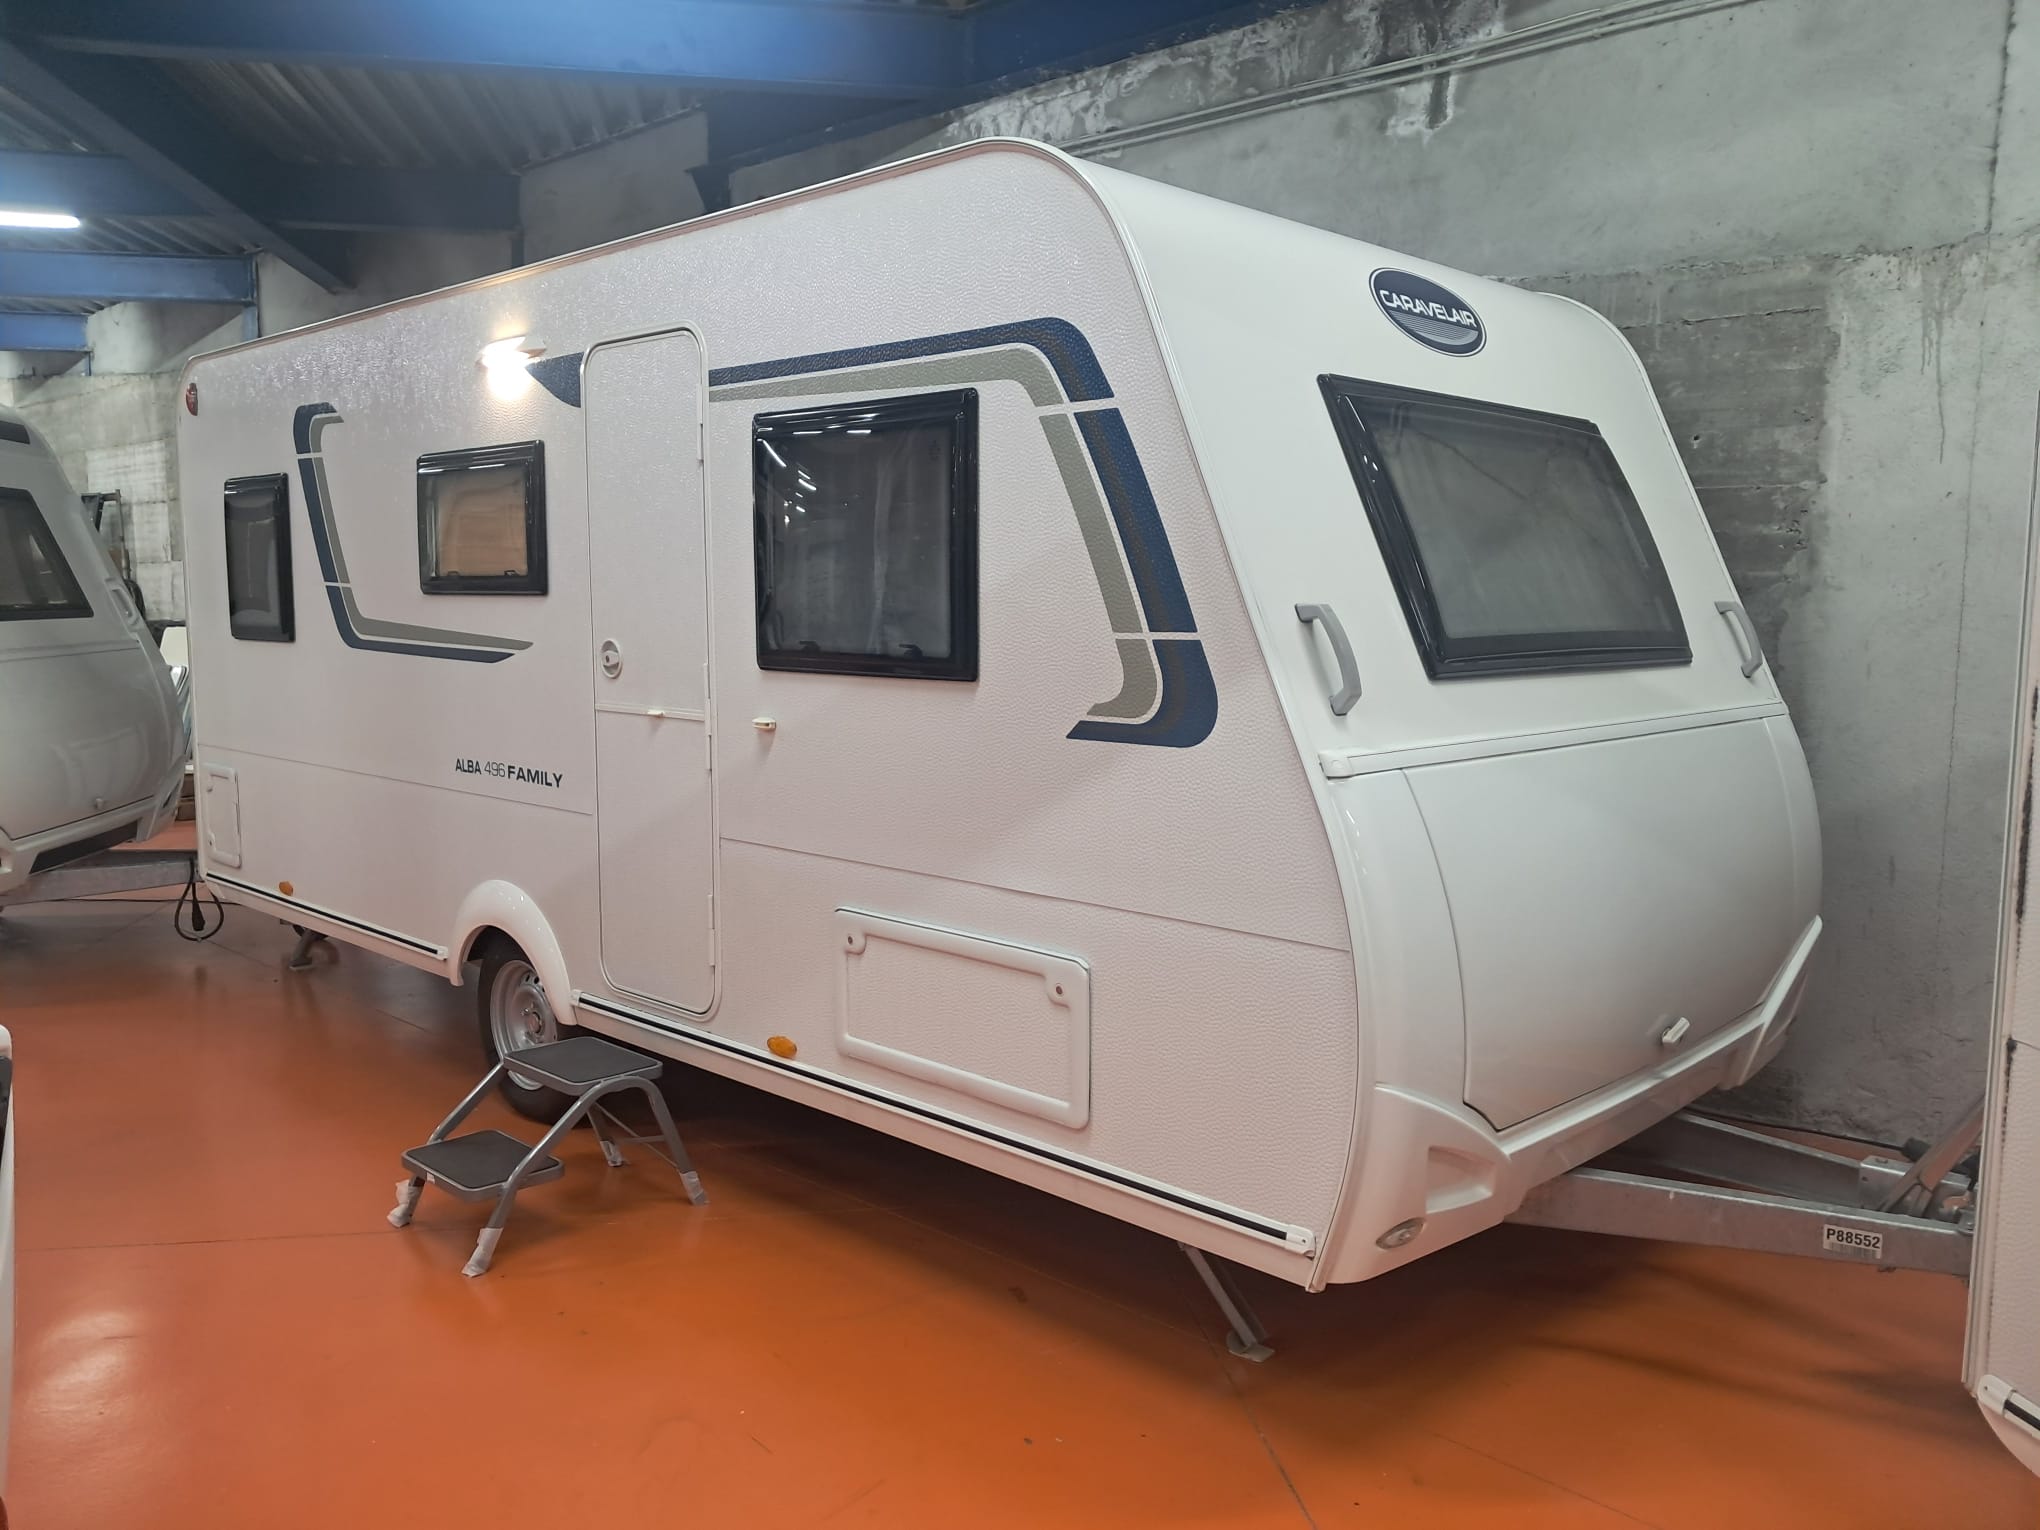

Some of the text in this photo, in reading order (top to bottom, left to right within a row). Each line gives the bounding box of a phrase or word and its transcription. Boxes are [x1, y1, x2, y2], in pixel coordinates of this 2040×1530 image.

[1379, 289, 1478, 328] CARAVELAIR
[455, 758, 563, 788] ALBA 496 FAMILY
[1826, 1228, 1881, 1249] P88552
